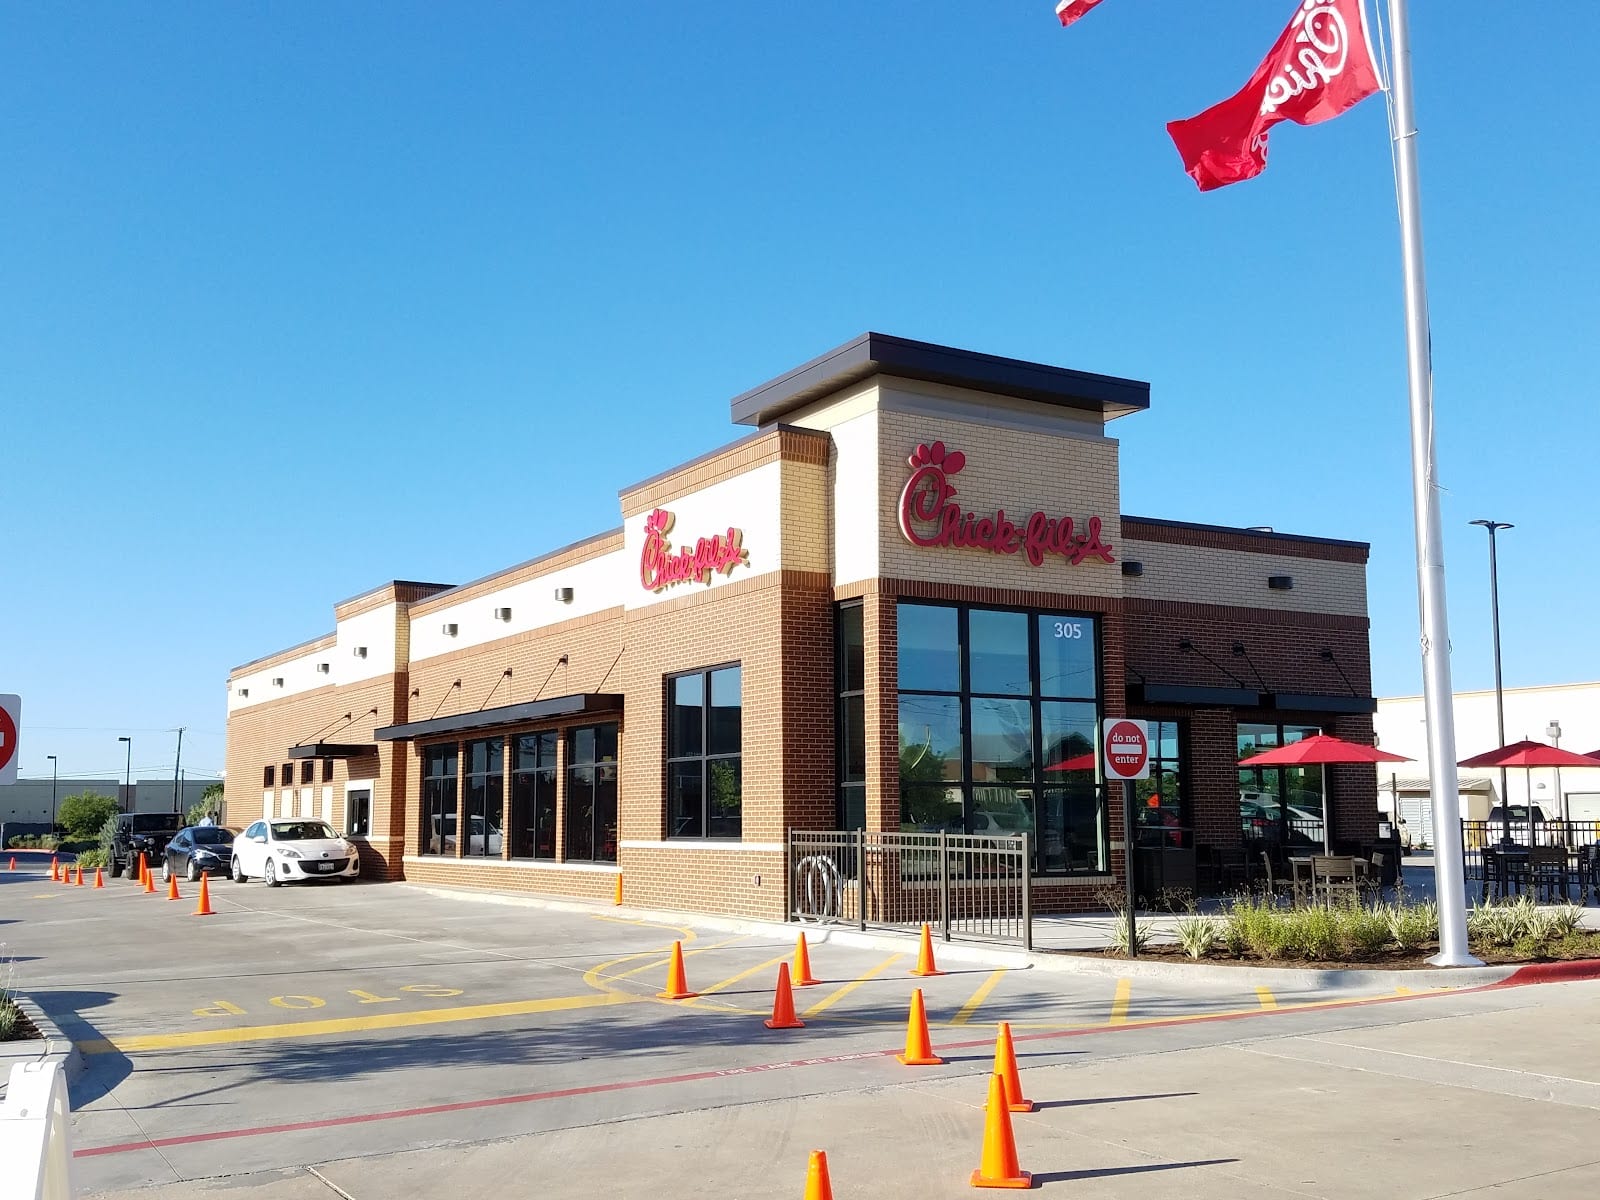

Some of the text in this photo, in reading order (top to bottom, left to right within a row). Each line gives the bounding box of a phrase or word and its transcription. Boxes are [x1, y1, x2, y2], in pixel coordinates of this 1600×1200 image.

[899, 440, 1116, 567] Chick-fil-A
[641, 507, 745, 591] Chick-fil-A
[1054, 622, 1082, 639] 305
[1112, 732, 1140, 743] do not
[1115, 755, 1139, 763] enter
[192, 984, 464, 1017] STOP
